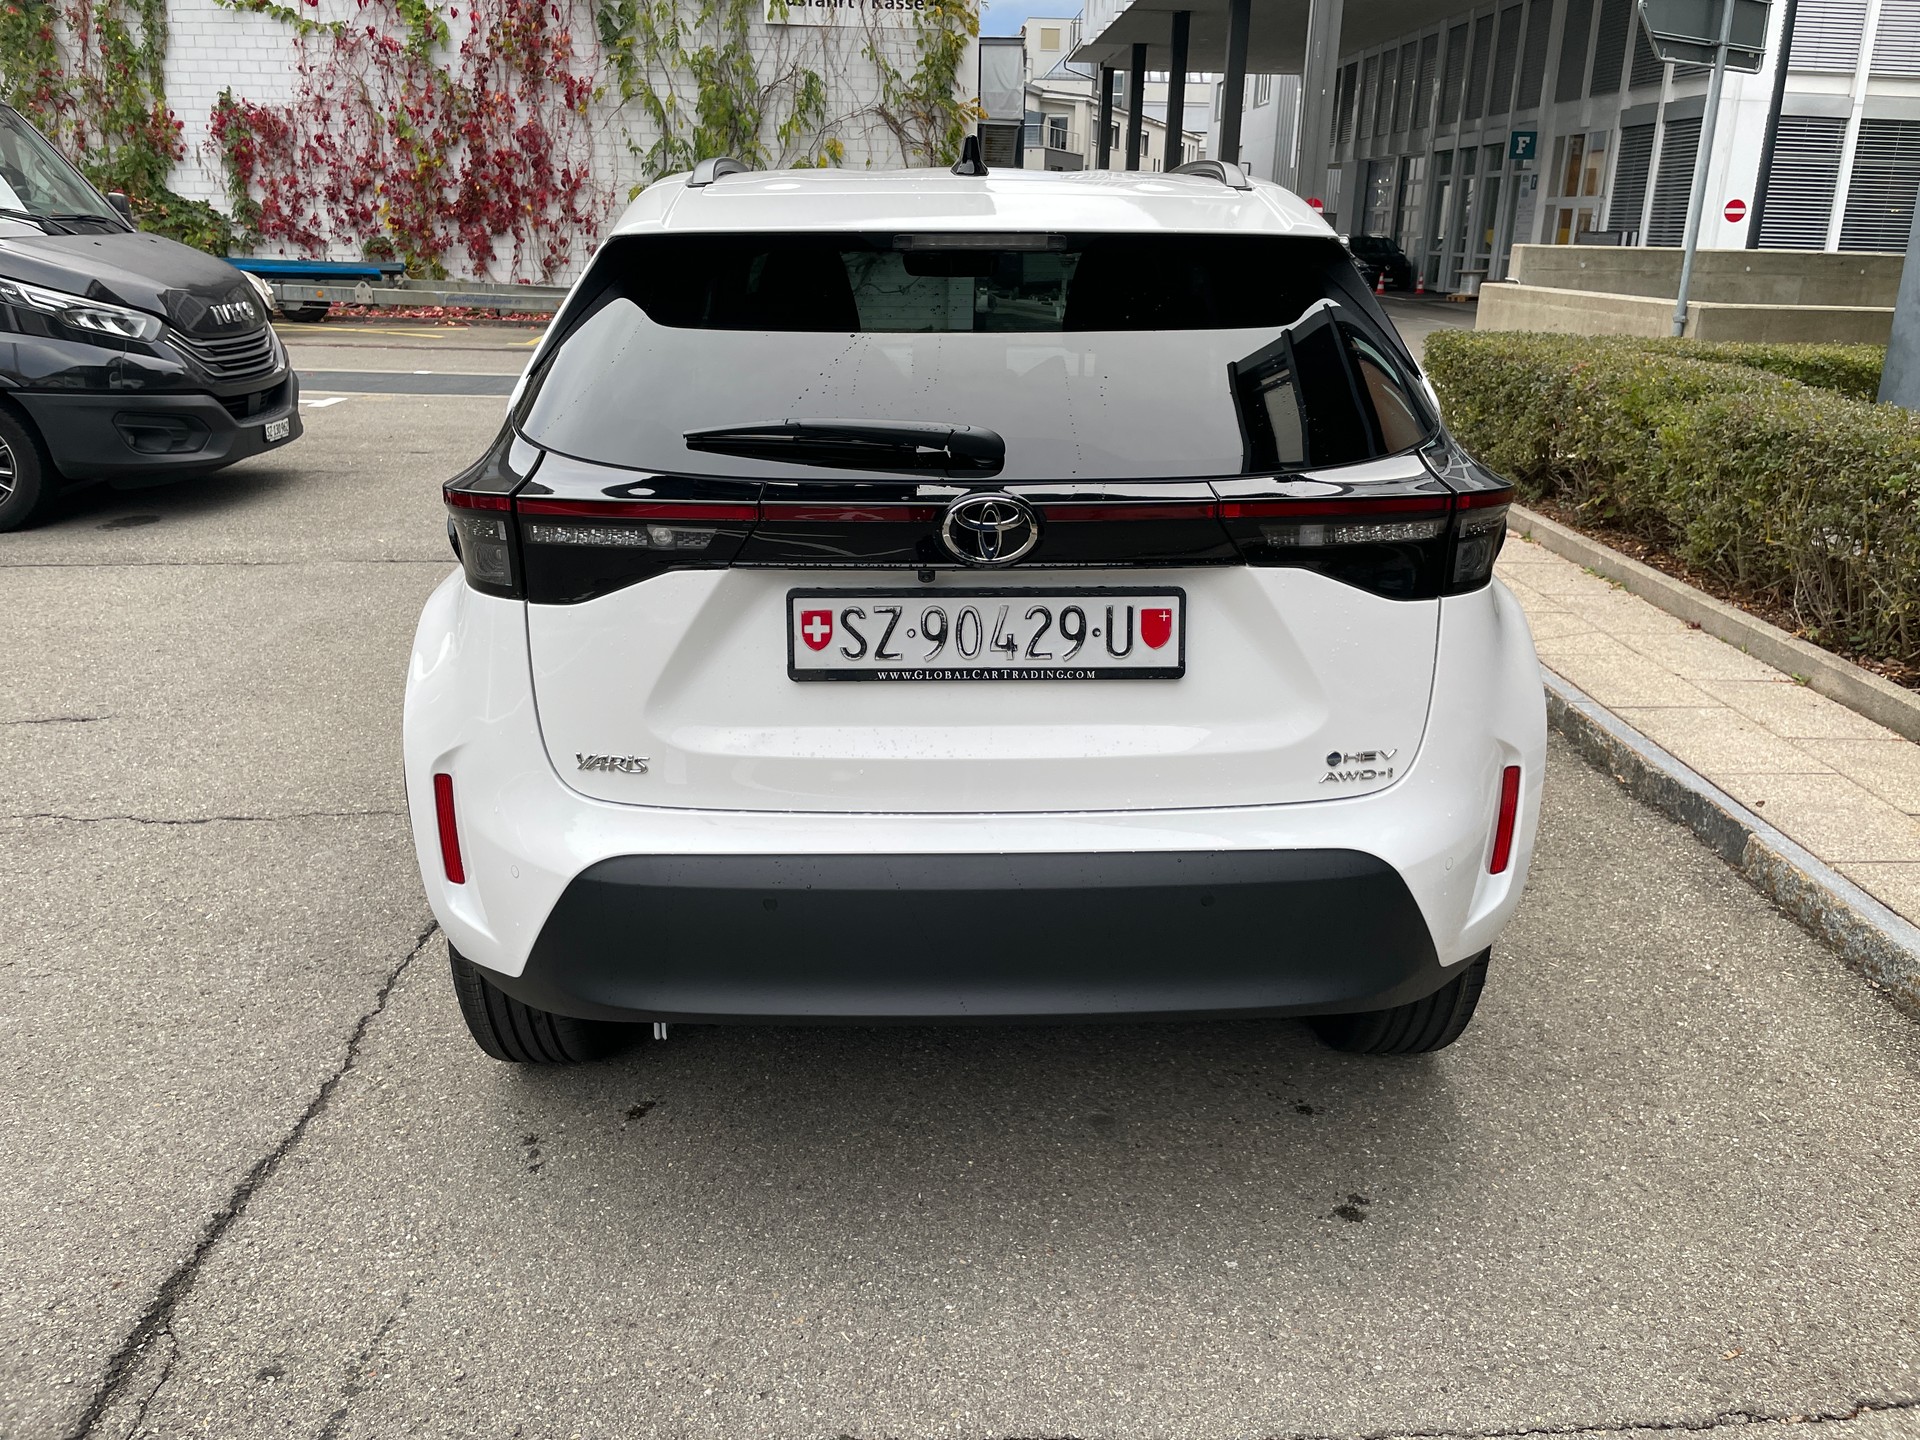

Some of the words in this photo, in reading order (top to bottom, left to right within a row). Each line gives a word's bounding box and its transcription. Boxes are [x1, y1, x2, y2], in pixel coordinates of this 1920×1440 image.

[872, 0, 924, 10] Kasse
[1516, 136, 1531, 154] F
[210, 301, 255, 325] IVECO
[1343, 748, 1397, 764] HEV
